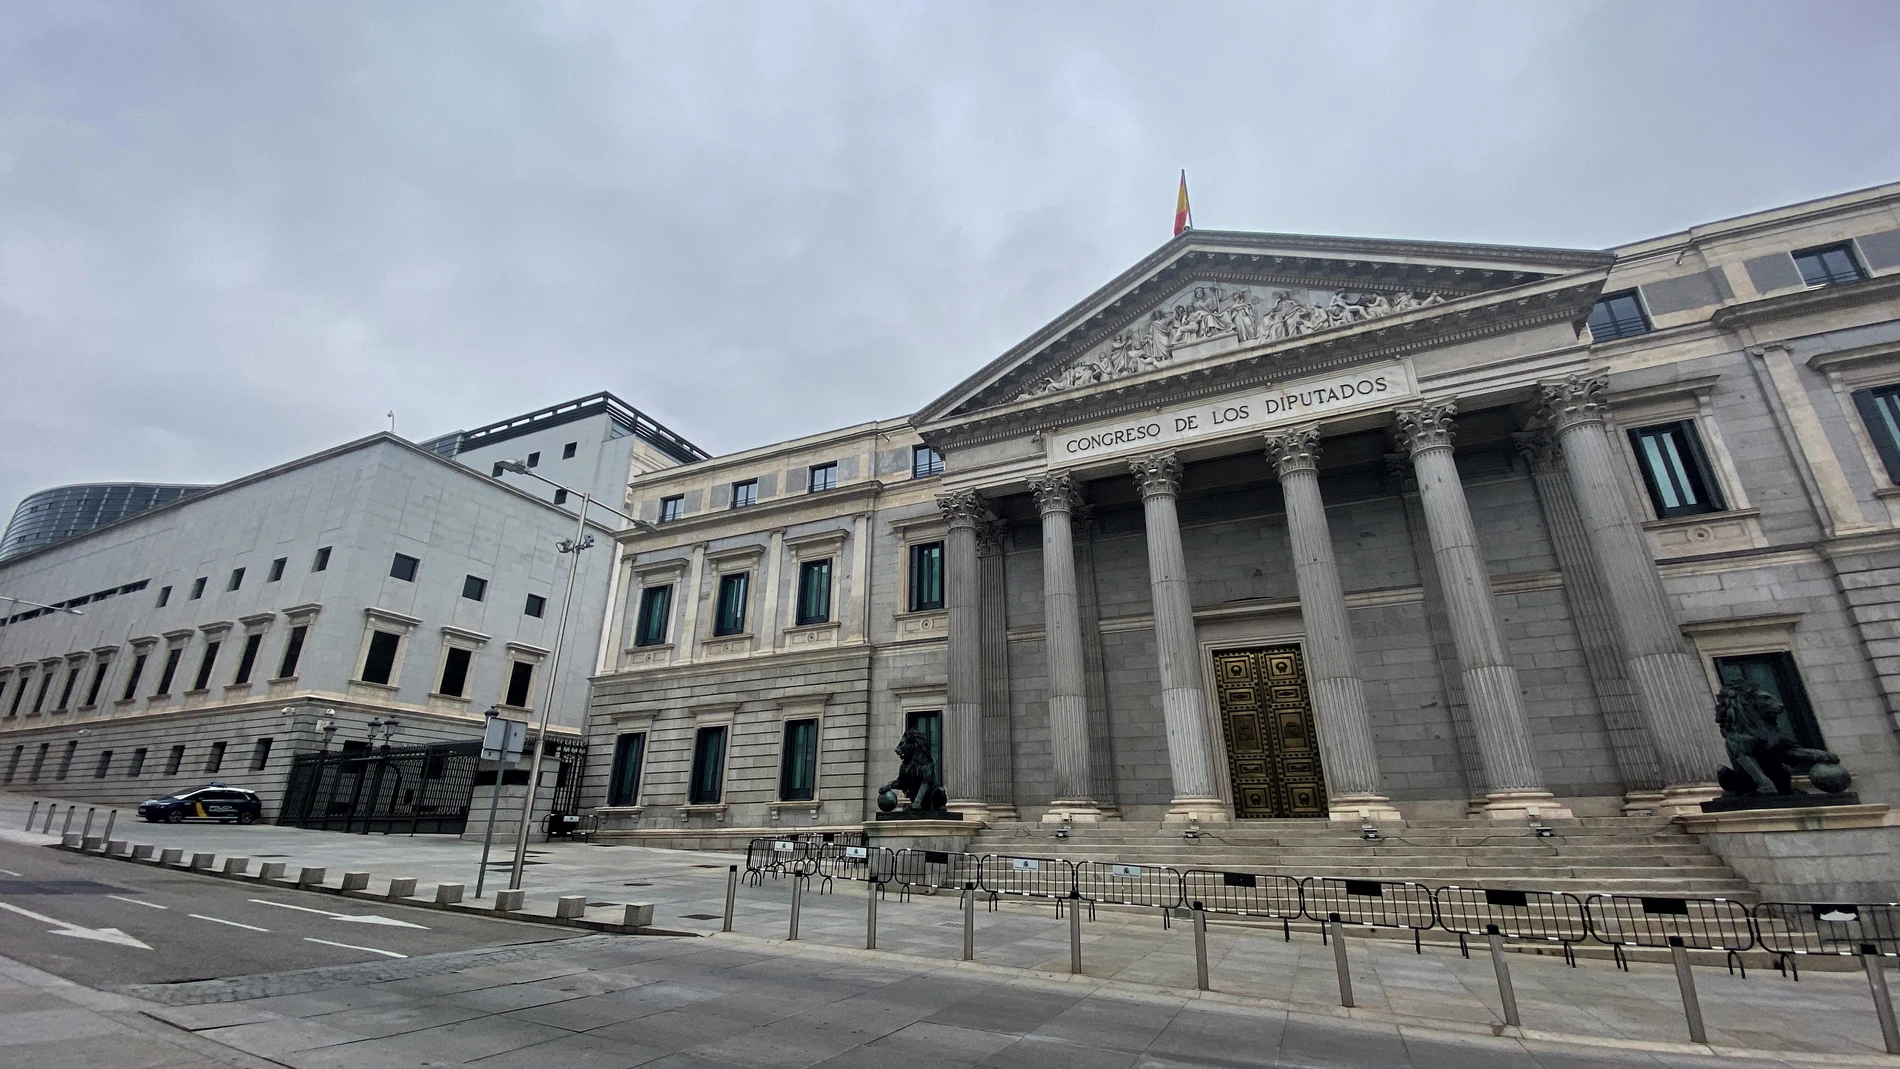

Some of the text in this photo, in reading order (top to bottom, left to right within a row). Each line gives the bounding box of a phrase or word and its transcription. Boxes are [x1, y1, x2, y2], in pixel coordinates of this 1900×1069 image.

[1066, 377, 1387, 453] CONGRESO DE LOS DIPUTADOS
